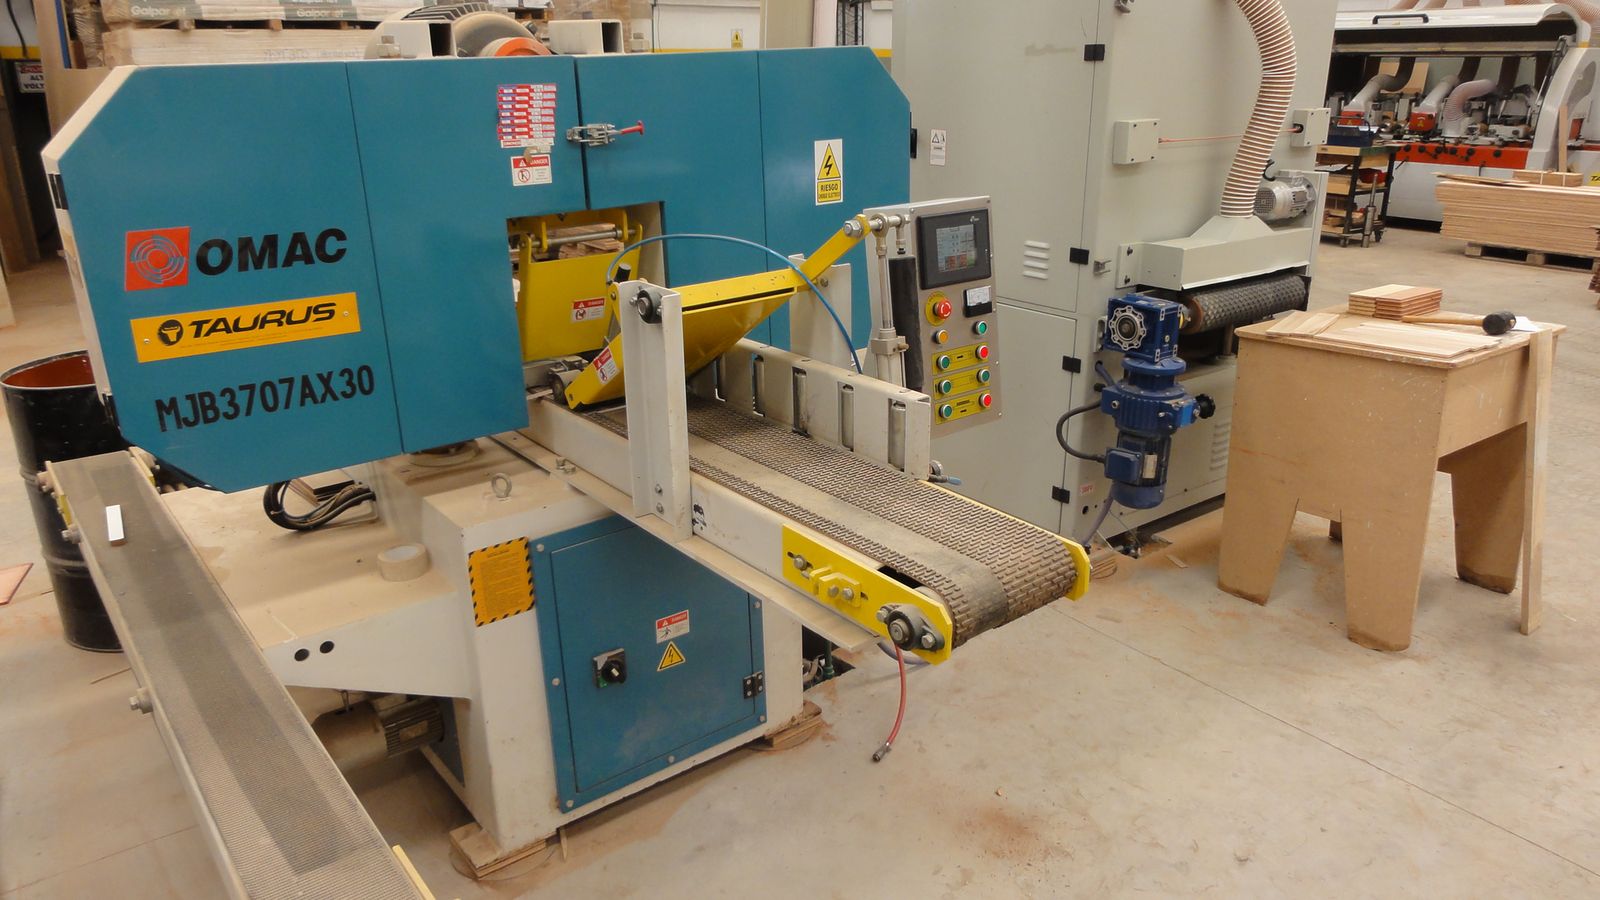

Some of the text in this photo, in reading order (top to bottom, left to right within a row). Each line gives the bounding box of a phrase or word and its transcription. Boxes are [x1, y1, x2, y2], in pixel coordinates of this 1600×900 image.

[820, 183, 839, 191] RIESGO
[196, 228, 348, 276] OMAC
[188, 302, 337, 339] TAURUS
[155, 364, 375, 433] MJB3707AX30
